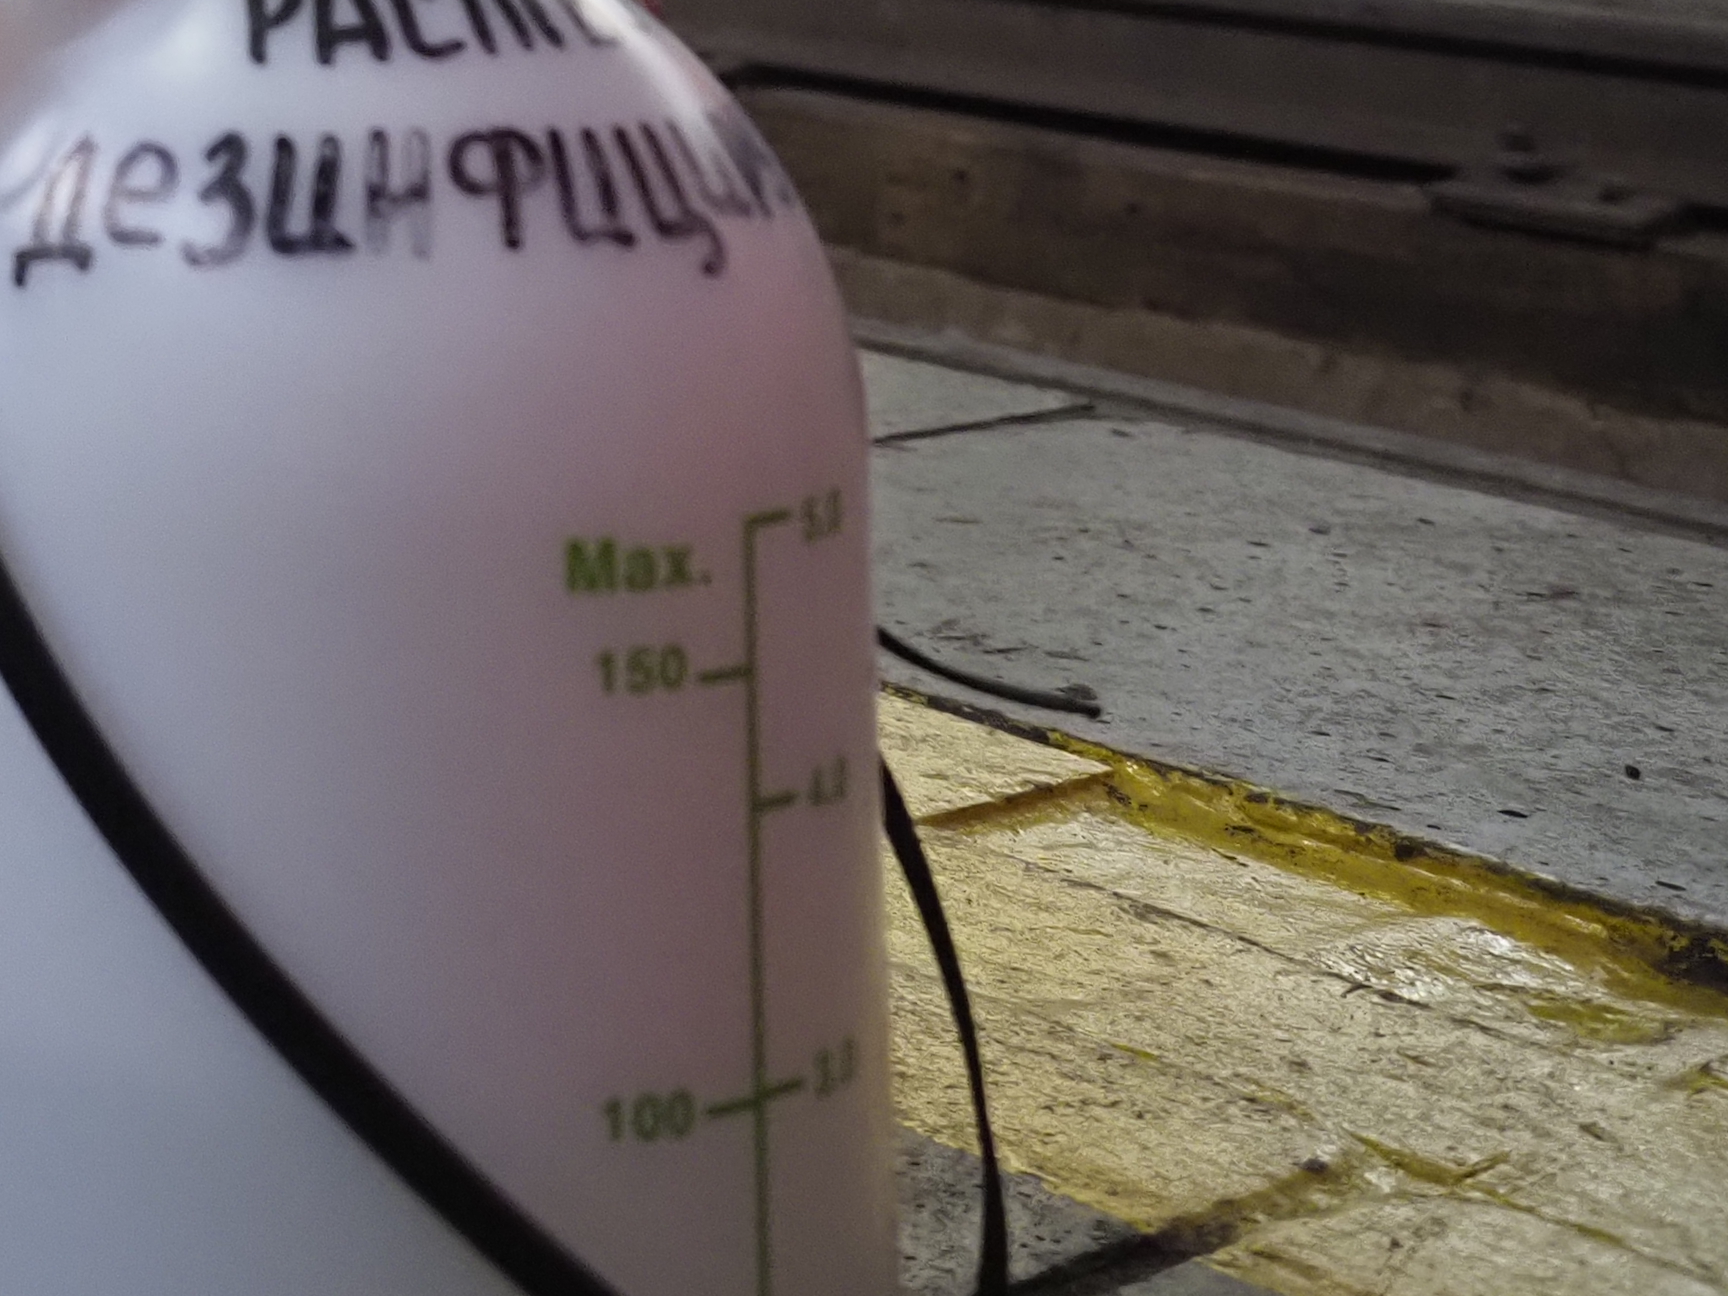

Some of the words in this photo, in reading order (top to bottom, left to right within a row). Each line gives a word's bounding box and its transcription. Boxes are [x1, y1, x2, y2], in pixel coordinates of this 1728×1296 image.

[564, 536, 712, 594] Max.
[596, 643, 687, 694] 150
[602, 1090, 697, 1143] 100
